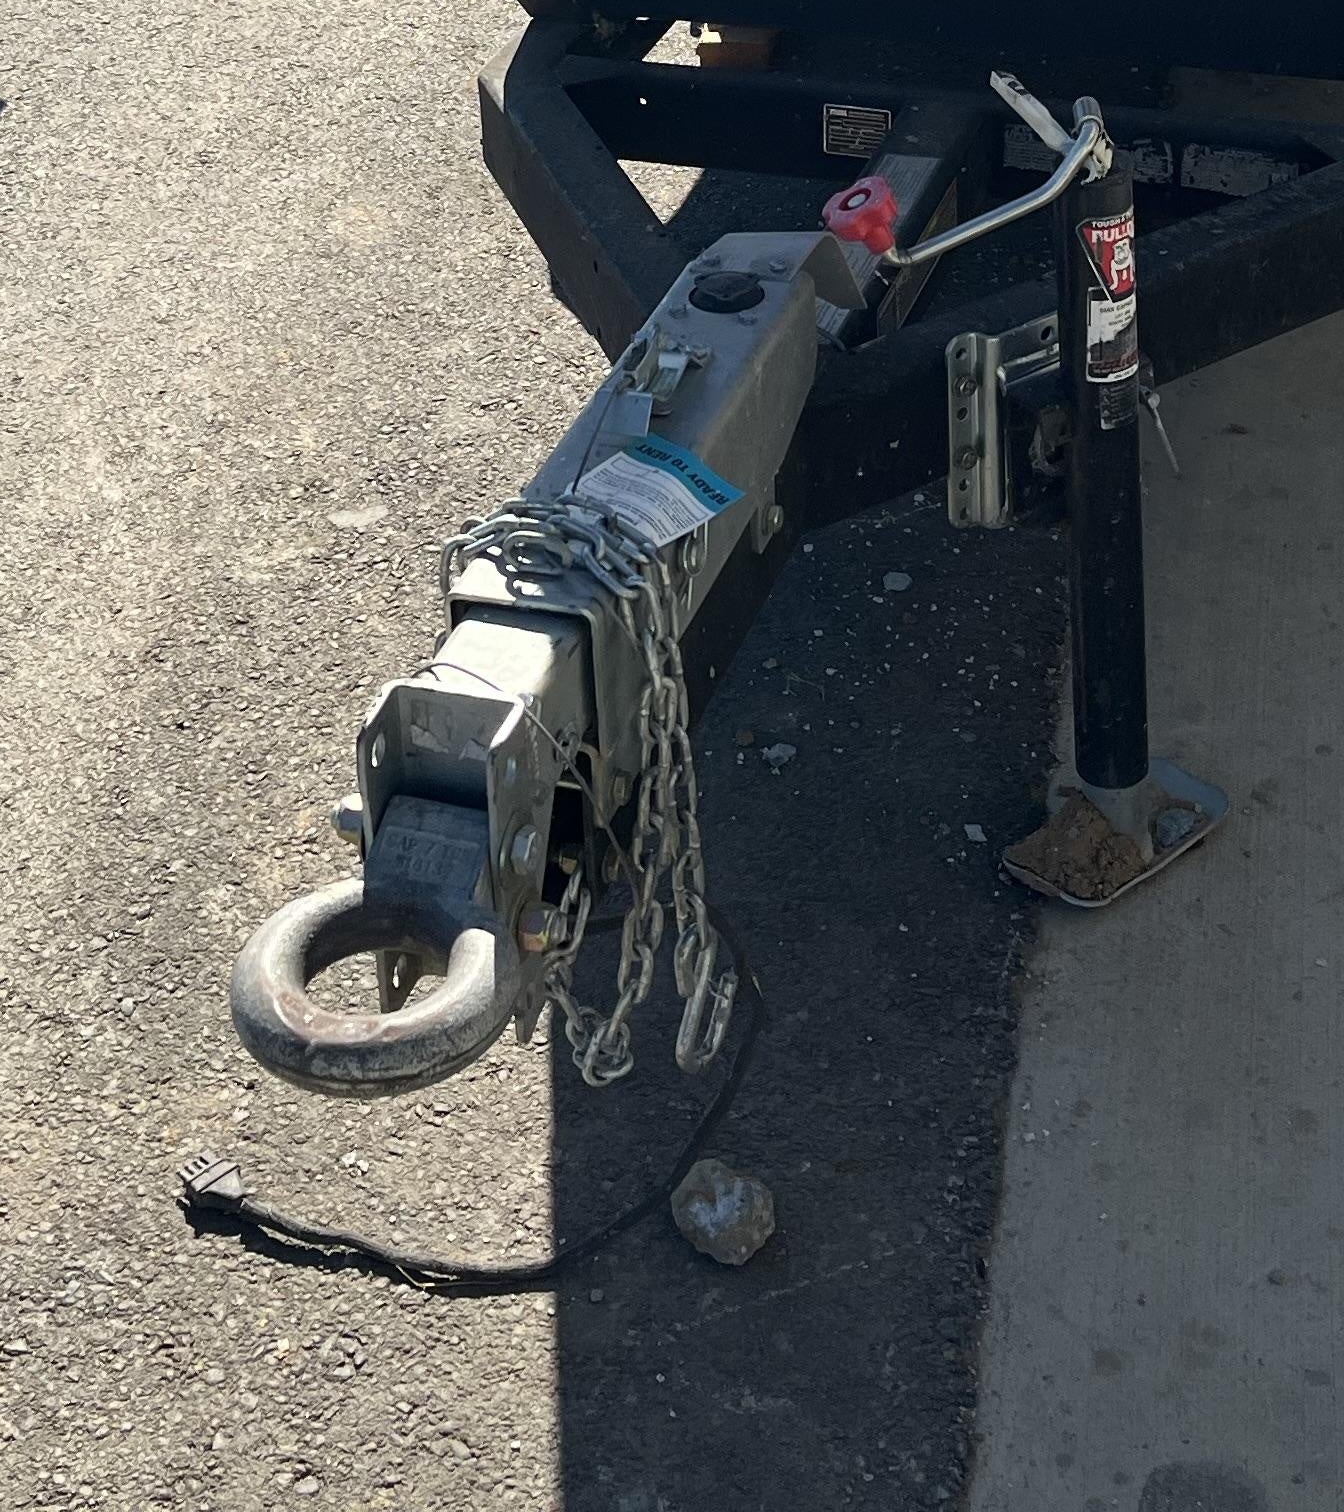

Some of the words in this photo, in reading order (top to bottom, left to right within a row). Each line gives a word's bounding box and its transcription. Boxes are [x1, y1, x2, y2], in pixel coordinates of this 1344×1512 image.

[635, 444, 673, 462] RENT
[671, 458, 689, 473] TO
[687, 473, 731, 505] READY
